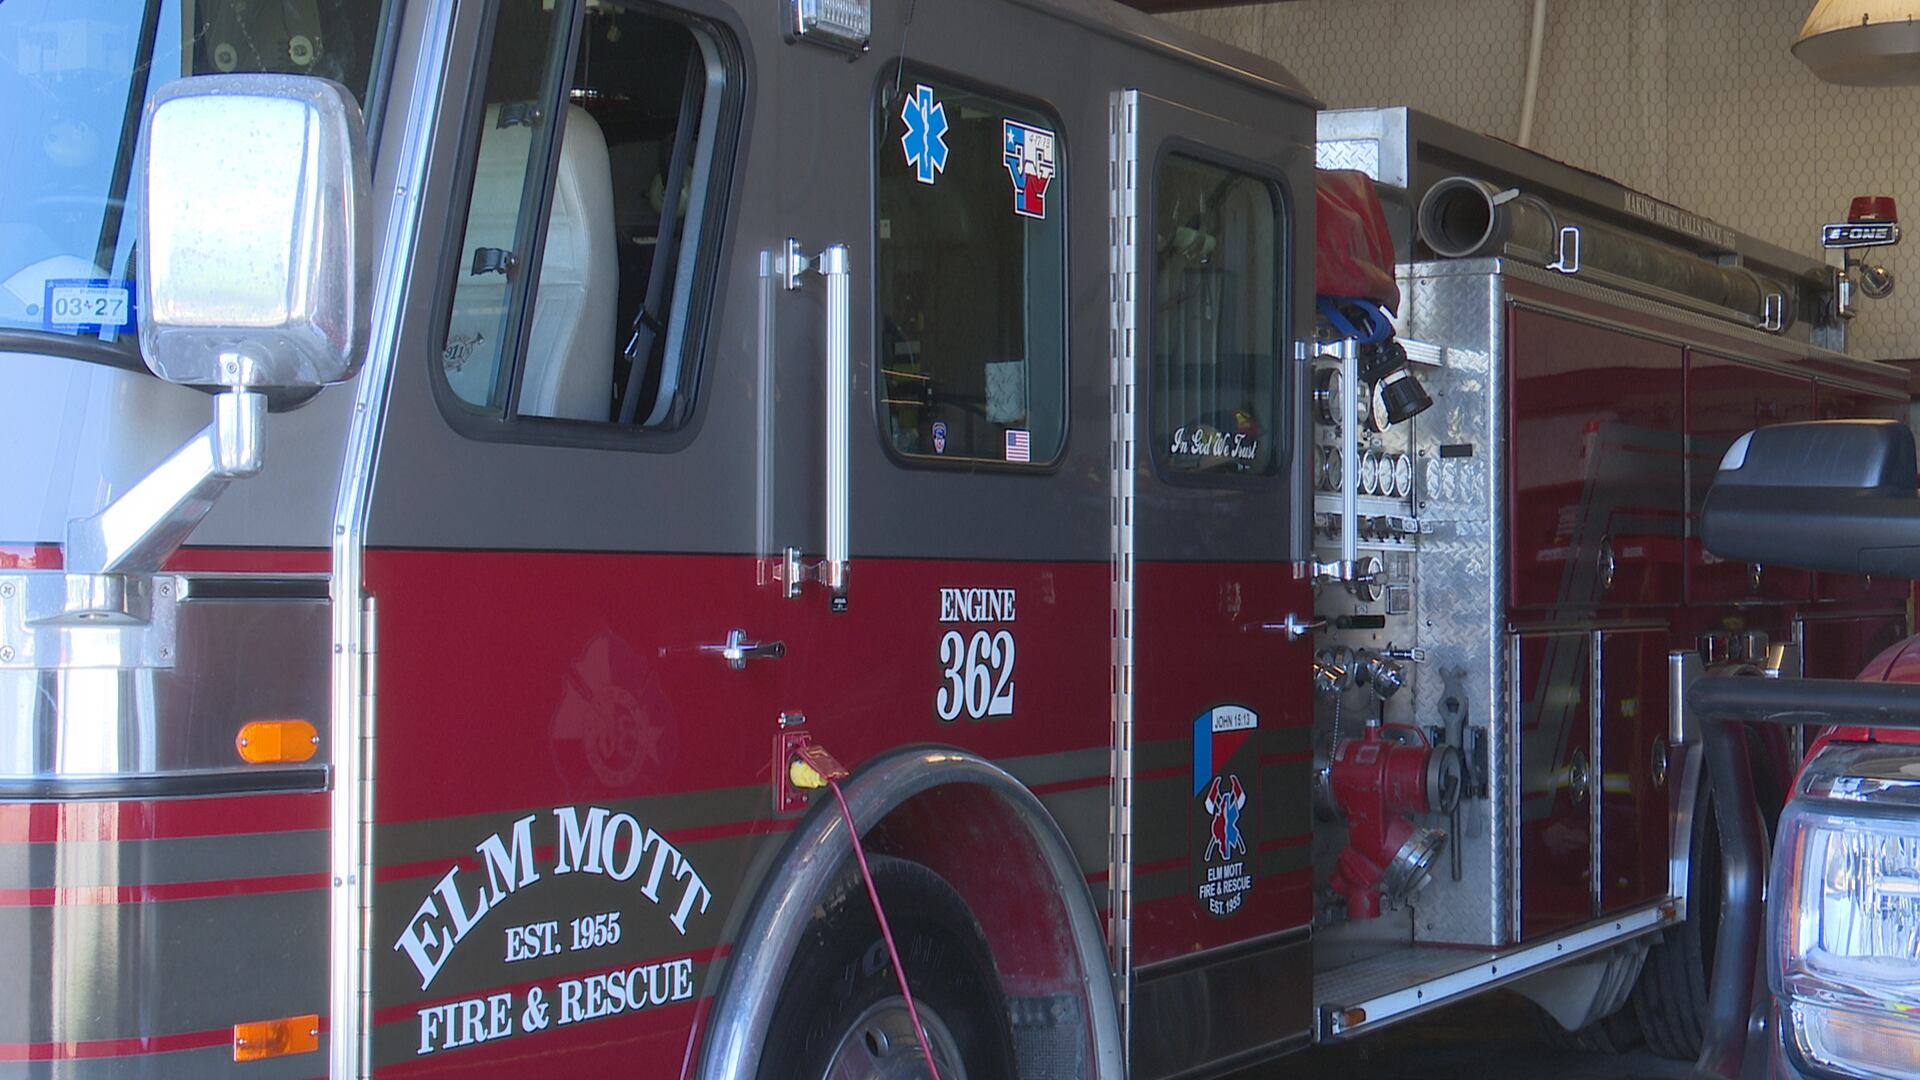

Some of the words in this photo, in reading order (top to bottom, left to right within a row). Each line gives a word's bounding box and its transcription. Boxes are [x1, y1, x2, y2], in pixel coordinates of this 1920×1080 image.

[1624, 191, 1656, 221] MAKING
[1656, 203, 1680, 229] HOUSE
[1680, 213, 1702, 237] CALLS
[1702, 221, 1722, 245] SINCE
[1829, 228, 1889, 239] E-ONE
[55, 297, 83, 316] 03
[95, 297, 124, 316] 27
[445, 344, 464, 360] 911
[1171, 427, 1188, 454] In
[1191, 428, 1212, 456] God
[1213, 431, 1230, 457] We
[1231, 433, 1257, 460] Trust
[939, 587, 1016, 622] ENGINE
[936, 629, 1015, 721] 362
[1215, 714, 1233, 729] JOHN
[1234, 712, 1251, 727] 15:13
[1208, 866, 1223, 882] ELM
[1223, 862, 1243, 879] MOTT
[393, 814, 540, 992] ELM
[553, 805, 713, 936] MOTT
[1199, 882, 1216, 899] FIRE
[1216, 881, 1222, 895] &
[1223, 875, 1251, 893] RESCUE
[1210, 898, 1225, 915] EST.
[1226, 892, 1241, 914] 1955
[504, 920, 562, 963] EST.
[569, 911, 621, 951] 1955
[416, 992, 513, 1055] FIRE
[521, 986, 549, 1033] &
[557, 958, 693, 1025] RESCUE
